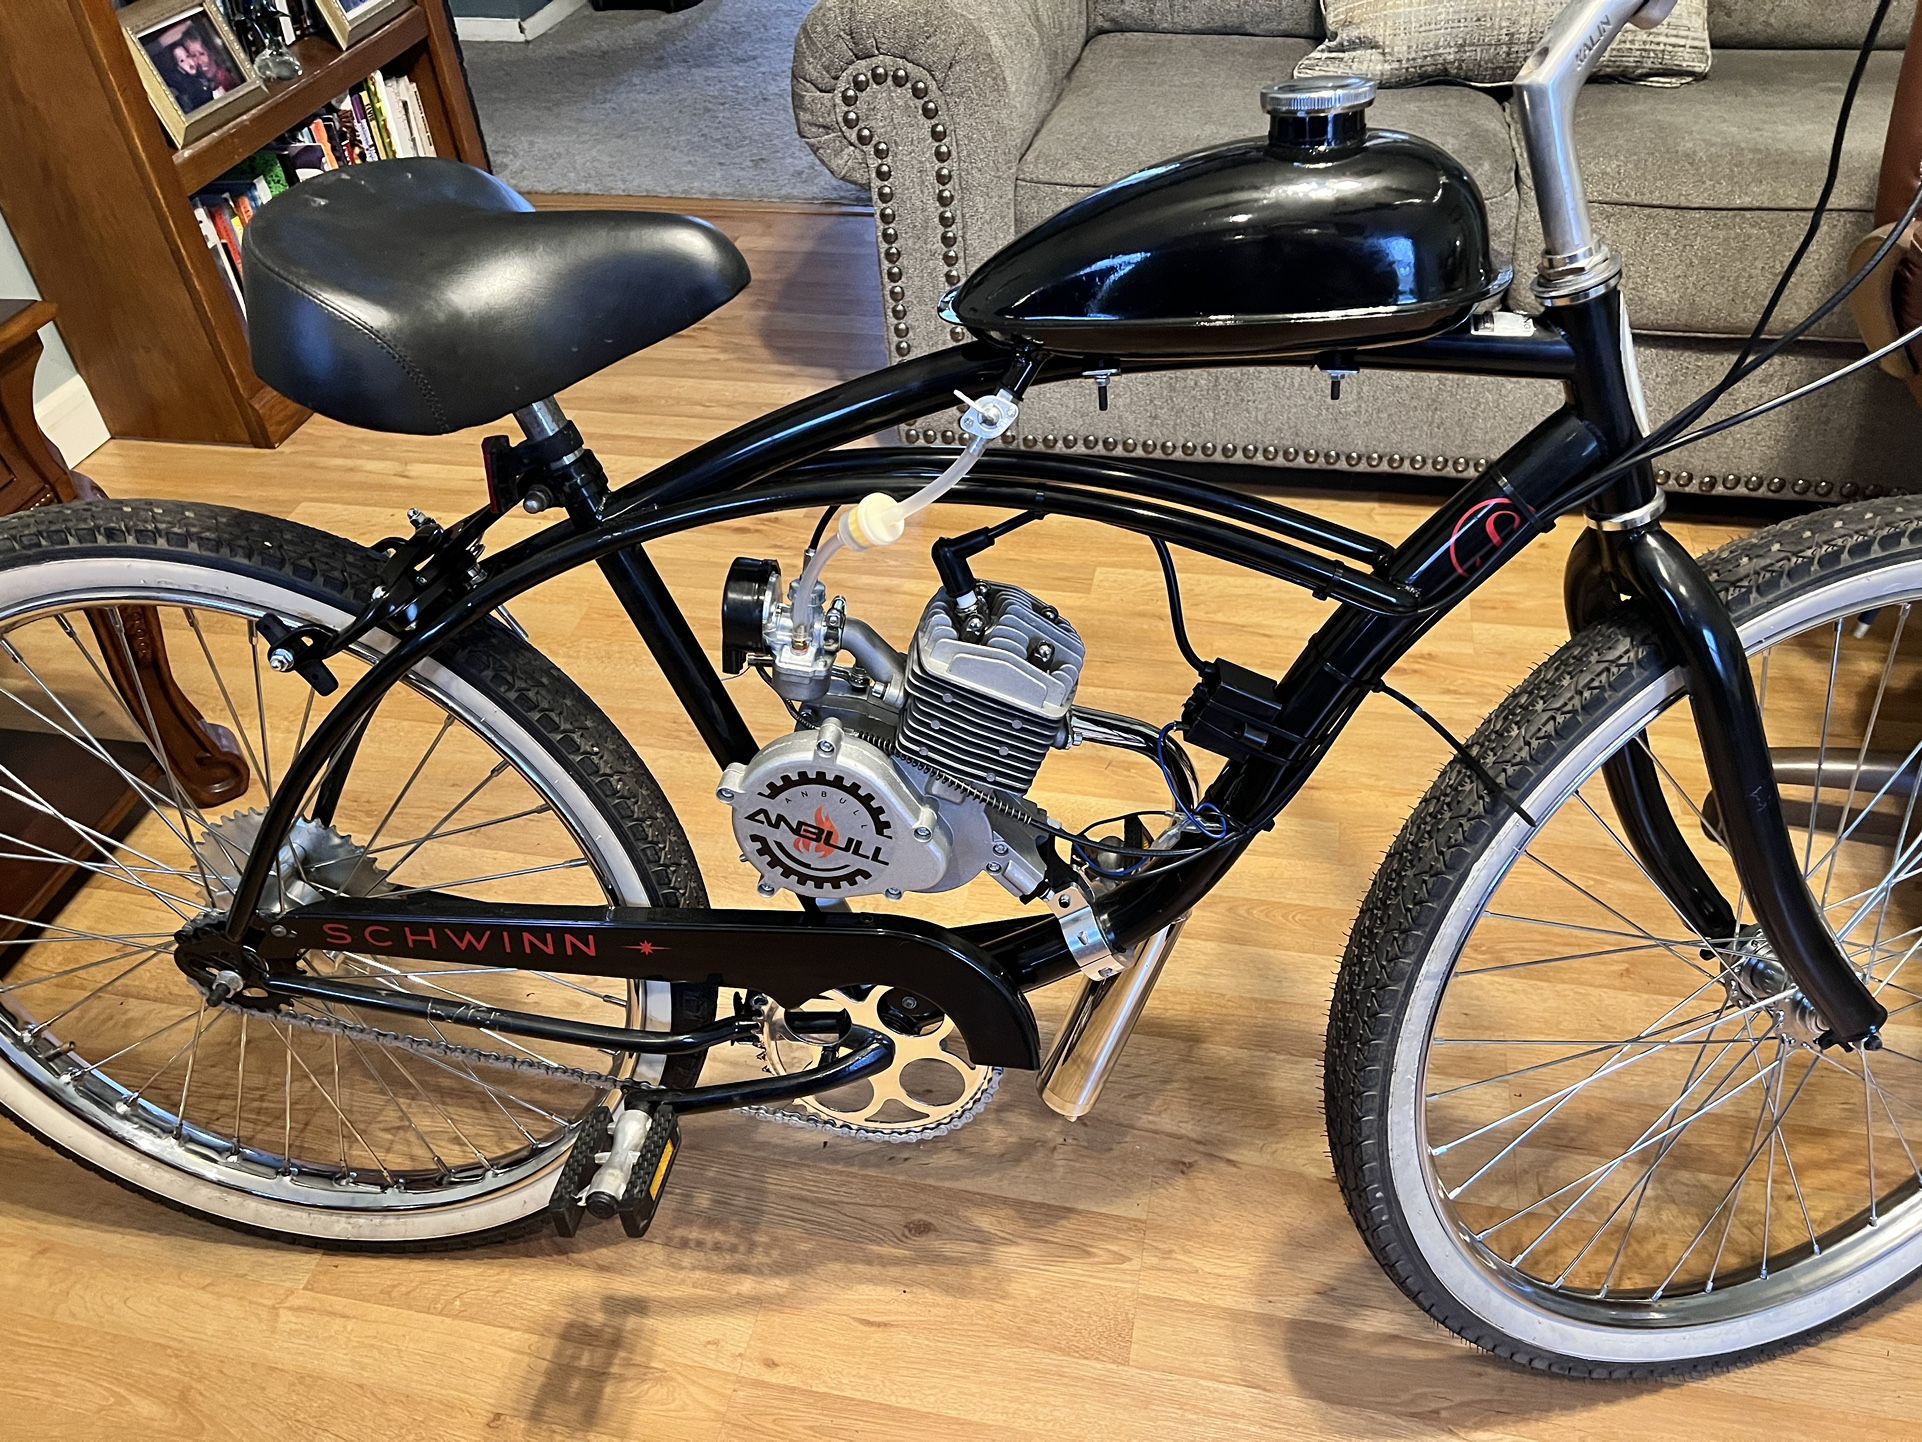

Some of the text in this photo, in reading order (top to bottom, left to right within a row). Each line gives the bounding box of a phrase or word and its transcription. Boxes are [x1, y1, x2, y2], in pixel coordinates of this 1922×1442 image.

[785, 790, 867, 829] ANBULL
[745, 808, 889, 866] ANBULL
[322, 923, 597, 957] SCHWINN
